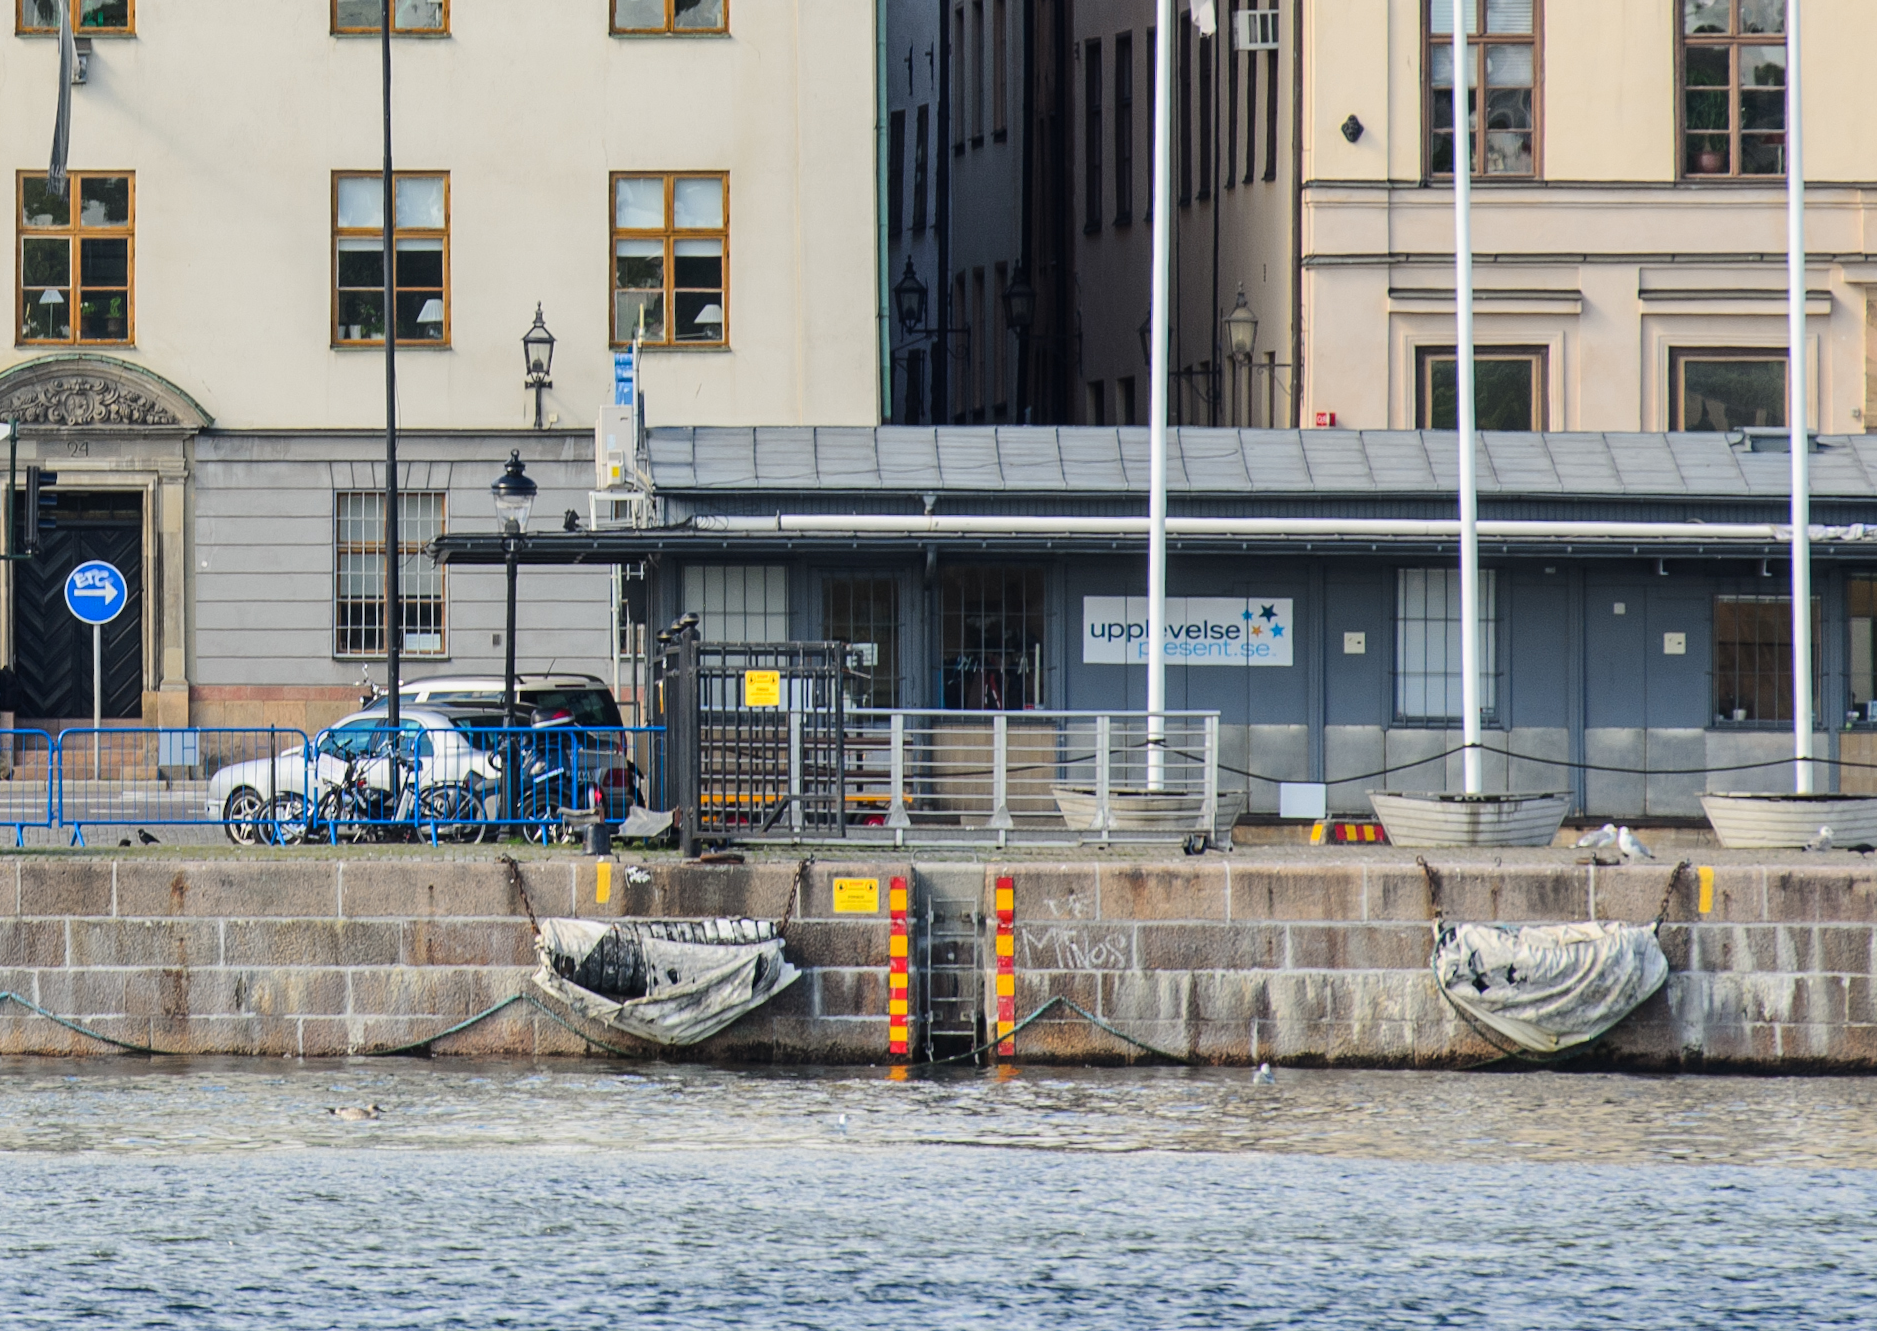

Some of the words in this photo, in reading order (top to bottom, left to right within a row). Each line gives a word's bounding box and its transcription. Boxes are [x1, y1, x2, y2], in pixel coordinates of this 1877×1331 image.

[67, 441, 89, 458] 24
[1090, 619, 1241, 642] upplvelse
[1138, 640, 1271, 658] pesent.se
